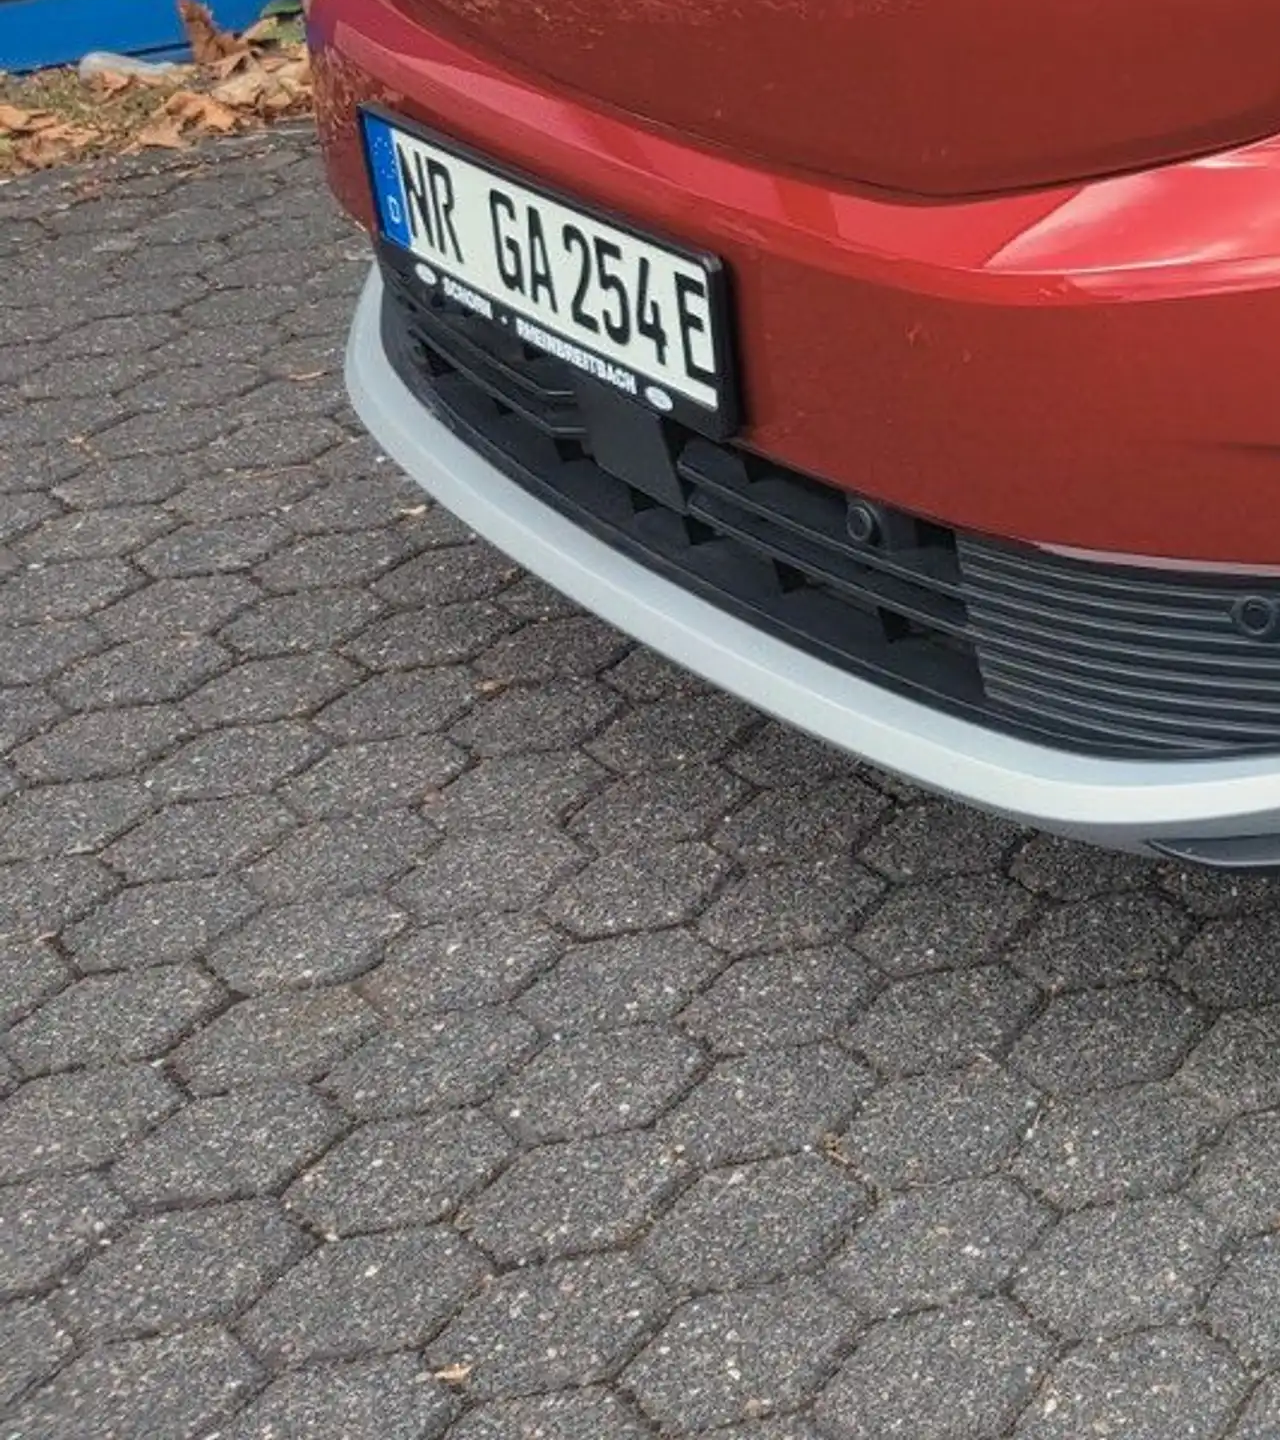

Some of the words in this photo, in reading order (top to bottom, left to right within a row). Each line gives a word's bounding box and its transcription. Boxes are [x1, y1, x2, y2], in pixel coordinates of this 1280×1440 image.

[397, 142, 464, 264] NR
[441, 276, 494, 320] SCHORN
[515, 316, 638, 394] RHEINBREITBACH
